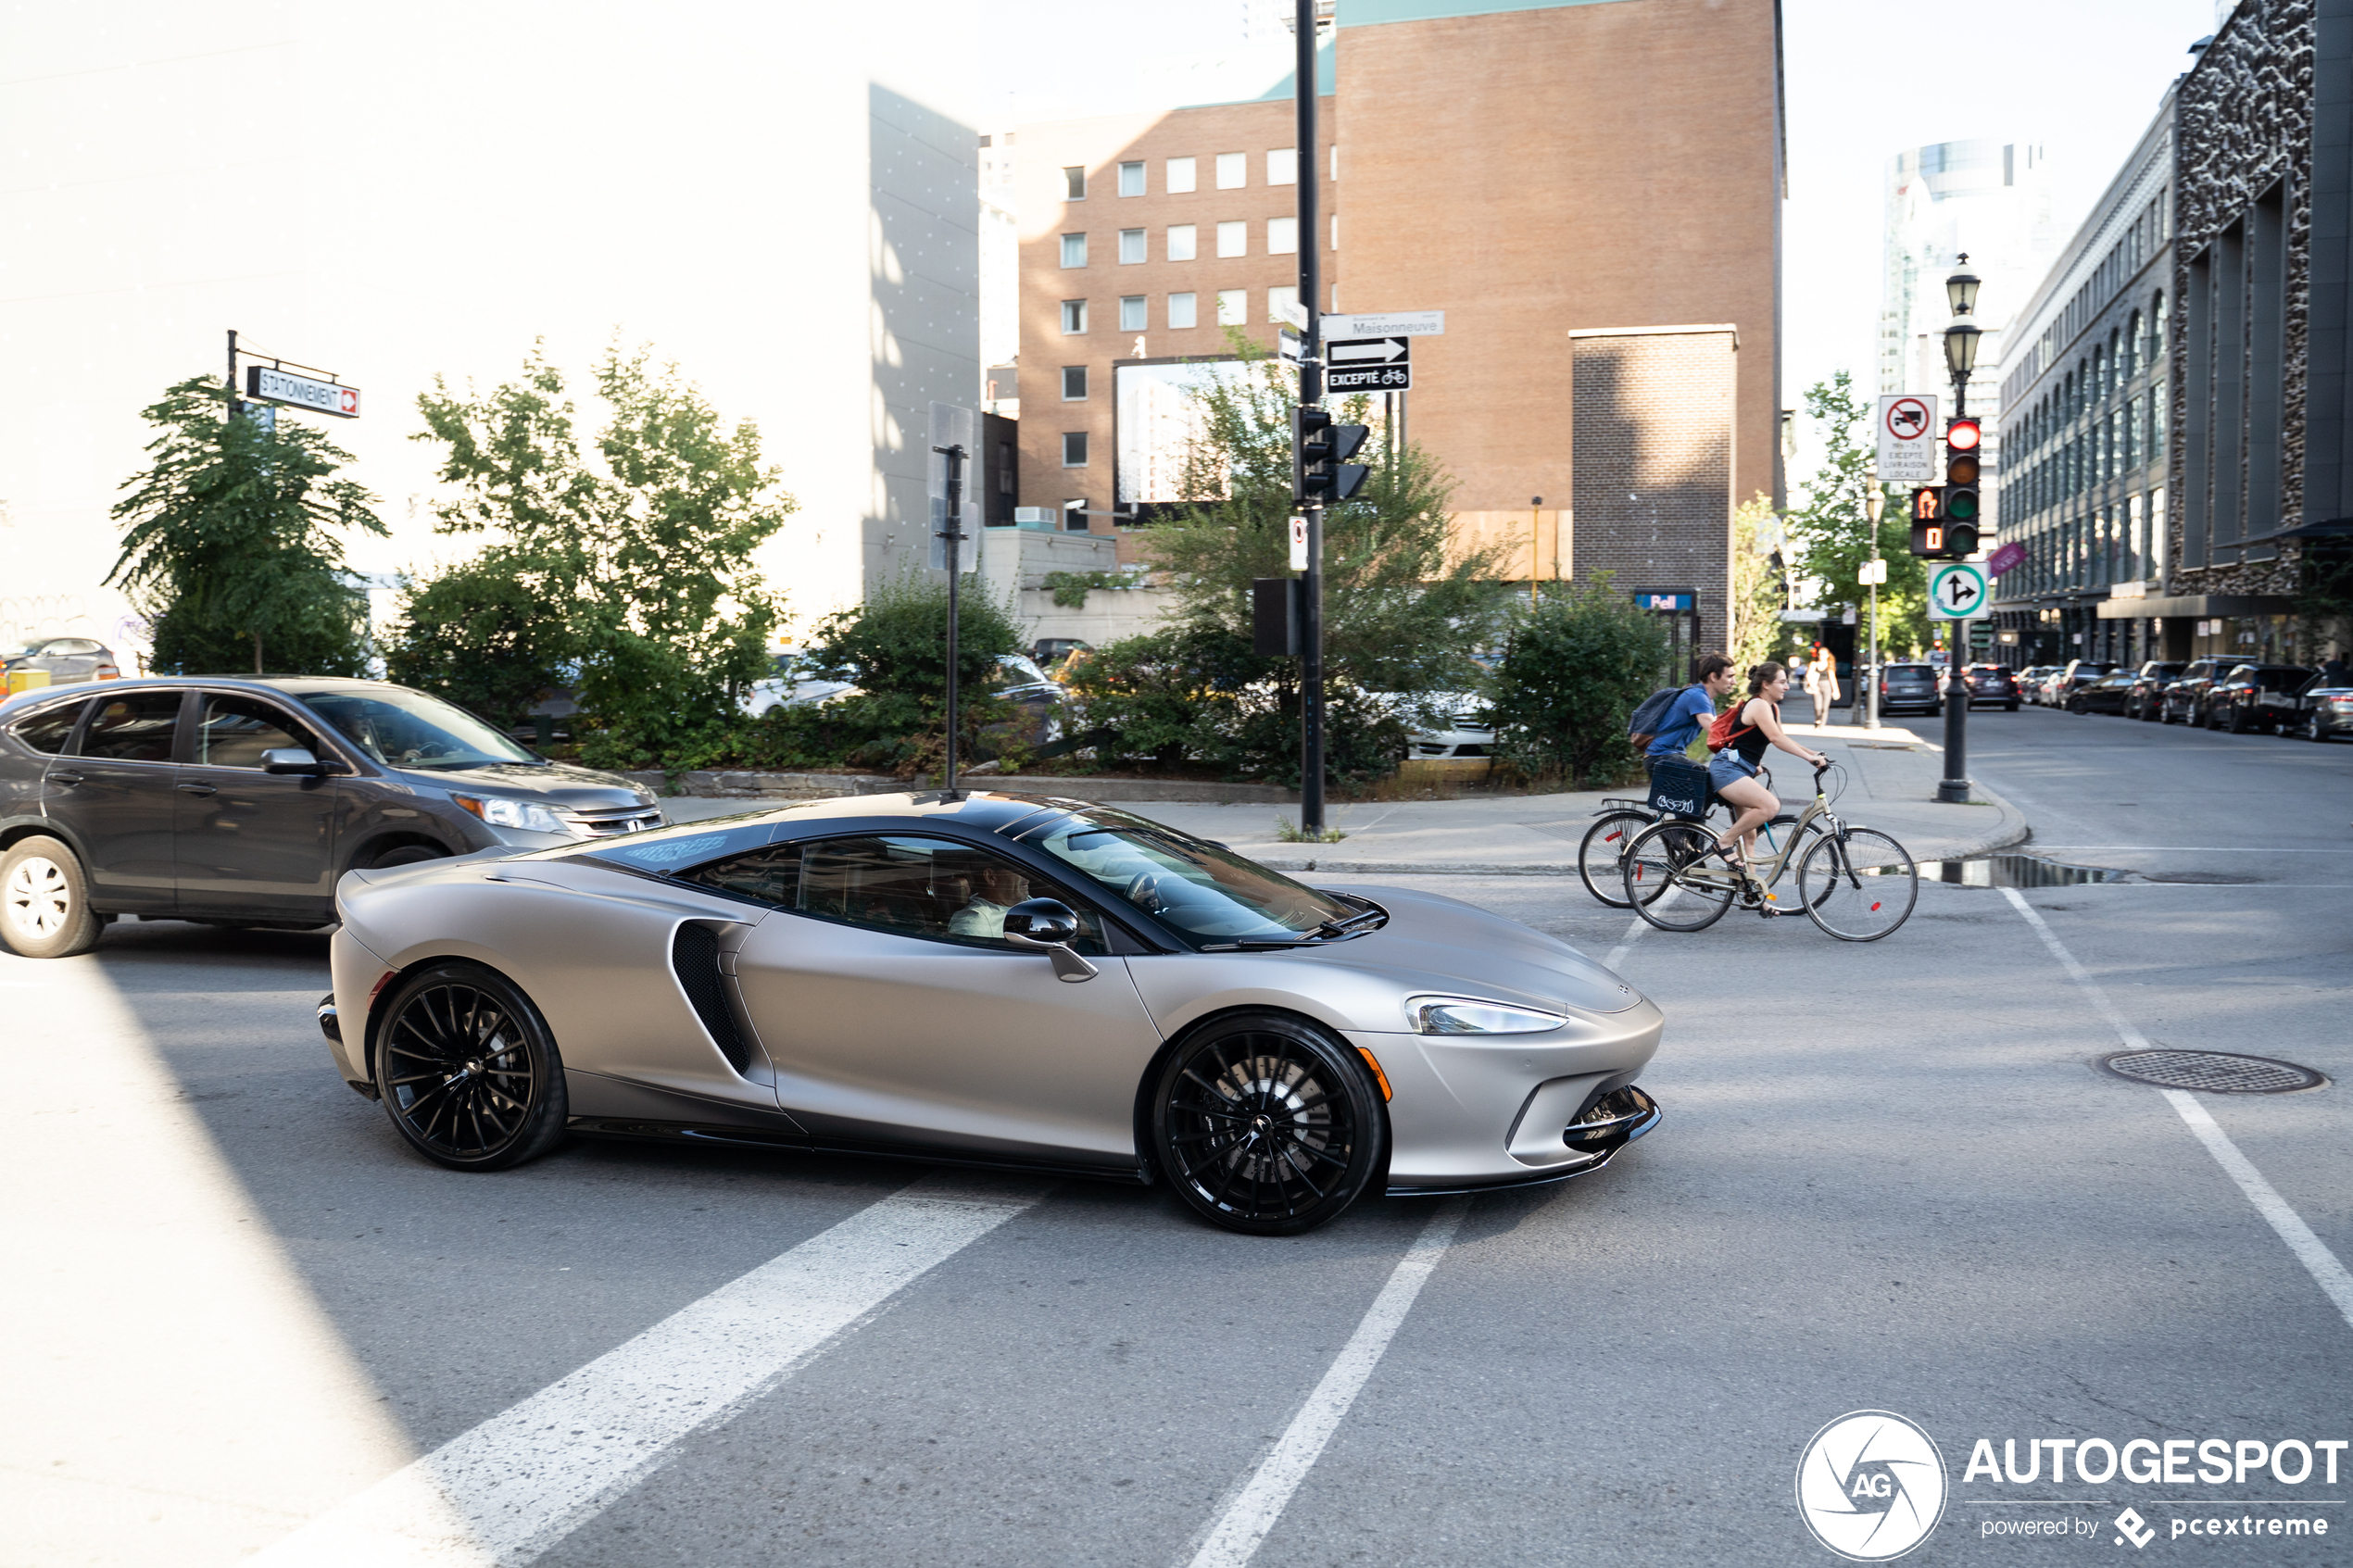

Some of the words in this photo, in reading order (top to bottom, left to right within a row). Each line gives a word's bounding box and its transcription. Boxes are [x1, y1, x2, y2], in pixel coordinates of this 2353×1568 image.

[1353, 322, 1437, 334] Maisonneuve
[1329, 370, 1380, 386] EXCEPTÉ
[261, 373, 338, 407] STATIONNEMENT
[1651, 596, 1677, 609] Bell
